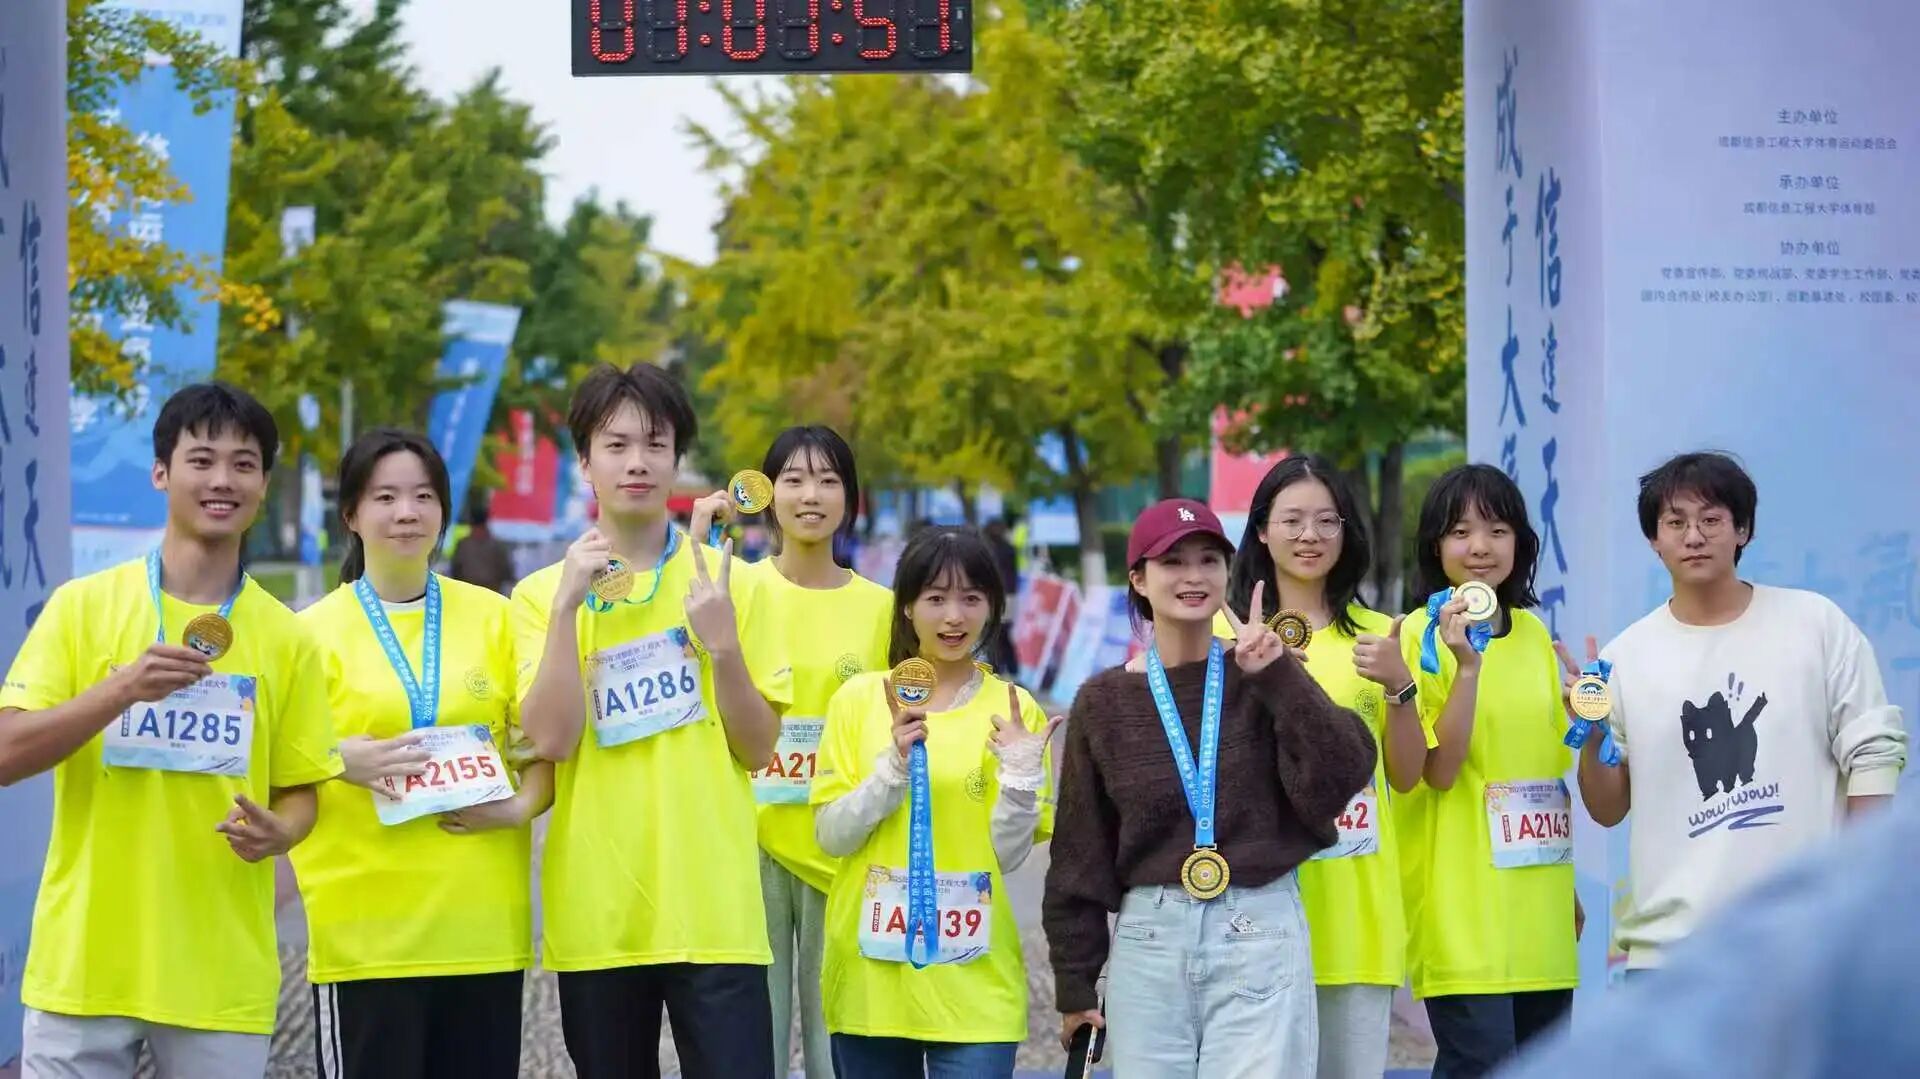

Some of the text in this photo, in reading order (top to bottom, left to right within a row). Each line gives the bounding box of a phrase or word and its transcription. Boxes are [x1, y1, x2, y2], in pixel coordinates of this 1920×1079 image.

[1777, 109, 1839, 125] 主办单位
[1779, 175, 1840, 190] 承办单位
[1780, 241, 1840, 256] 协办单位
[1177, 507, 1195, 521] LA
[606, 665, 695, 717] A1286
[136, 707, 241, 745] A1285
[405, 755, 496, 793] A2155
[765, 752, 816, 778] A21
[1518, 812, 1570, 840] A2143
